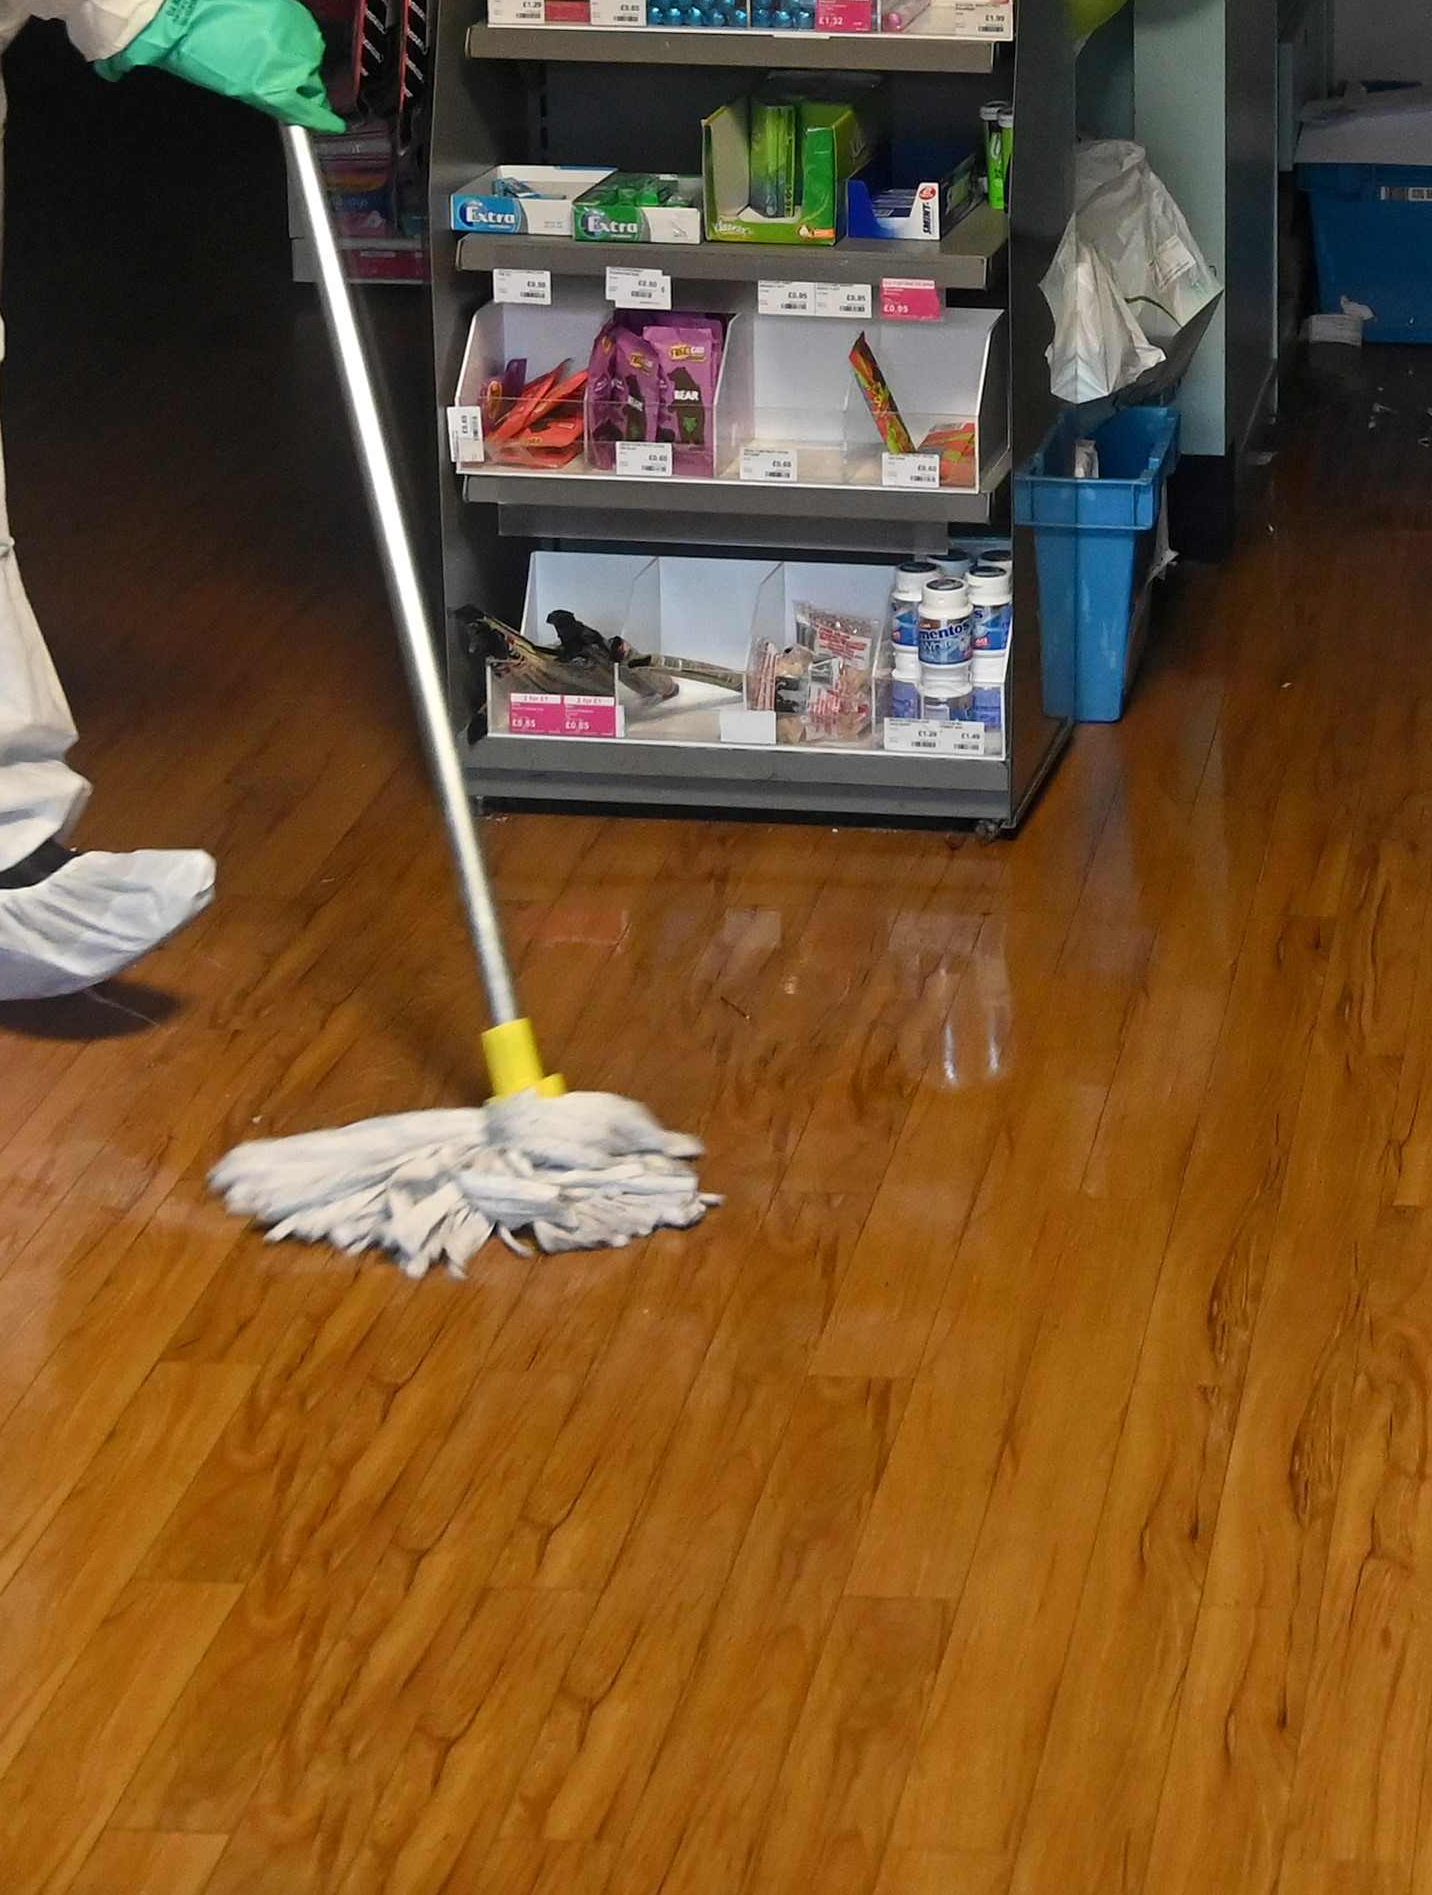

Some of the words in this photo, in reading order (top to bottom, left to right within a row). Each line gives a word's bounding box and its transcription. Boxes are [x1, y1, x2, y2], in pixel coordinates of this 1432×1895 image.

[465, 205, 515, 224] Extra
[587, 215, 638, 233] Extra
[674, 390, 700, 401] BEAR
[919, 623, 971, 641] mentos
